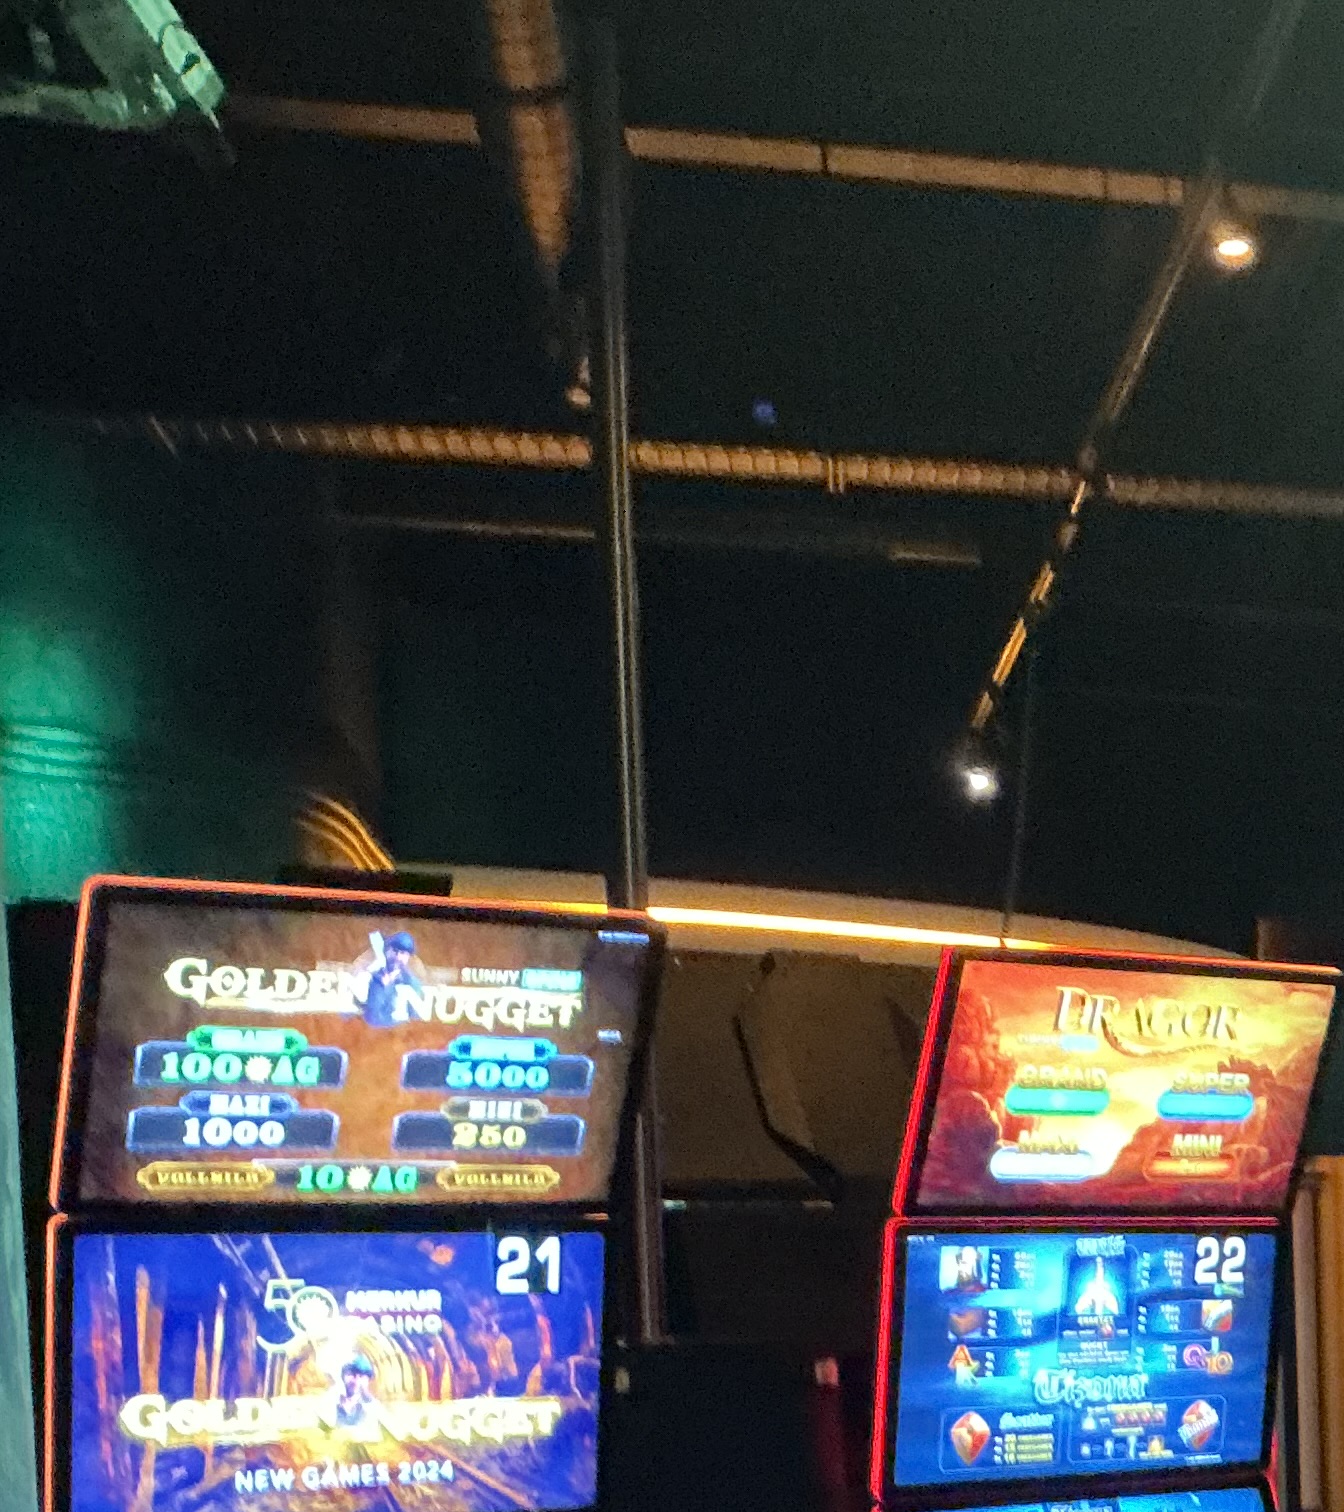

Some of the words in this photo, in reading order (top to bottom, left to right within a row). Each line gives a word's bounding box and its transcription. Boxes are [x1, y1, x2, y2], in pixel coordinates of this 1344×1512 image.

[461, 967, 519, 984] SUNNY
[164, 957, 372, 1008] GOLDEN
[392, 983, 582, 1033] NUGGET
[160, 1052, 243, 1083] 100
[446, 1061, 549, 1091] 5000
[1171, 1071, 1250, 1095] SUPER
[183, 1117, 285, 1147] 1000
[453, 1122, 527, 1150] 250
[1171, 1134, 1222, 1158] MINI
[297, 1164, 344, 1193] 10
[497, 1236, 561, 1294] 21
[1195, 1237, 1246, 1284] 22
[346, 1314, 442, 1334] ASINO
[119, 1394, 336, 1447] GOLDEN
[353, 1397, 561, 1445] NUGGET
[234, 1468, 294, 1493] NEW
[301, 1462, 390, 1492] GAMES
[398, 1460, 454, 1483] 2024
